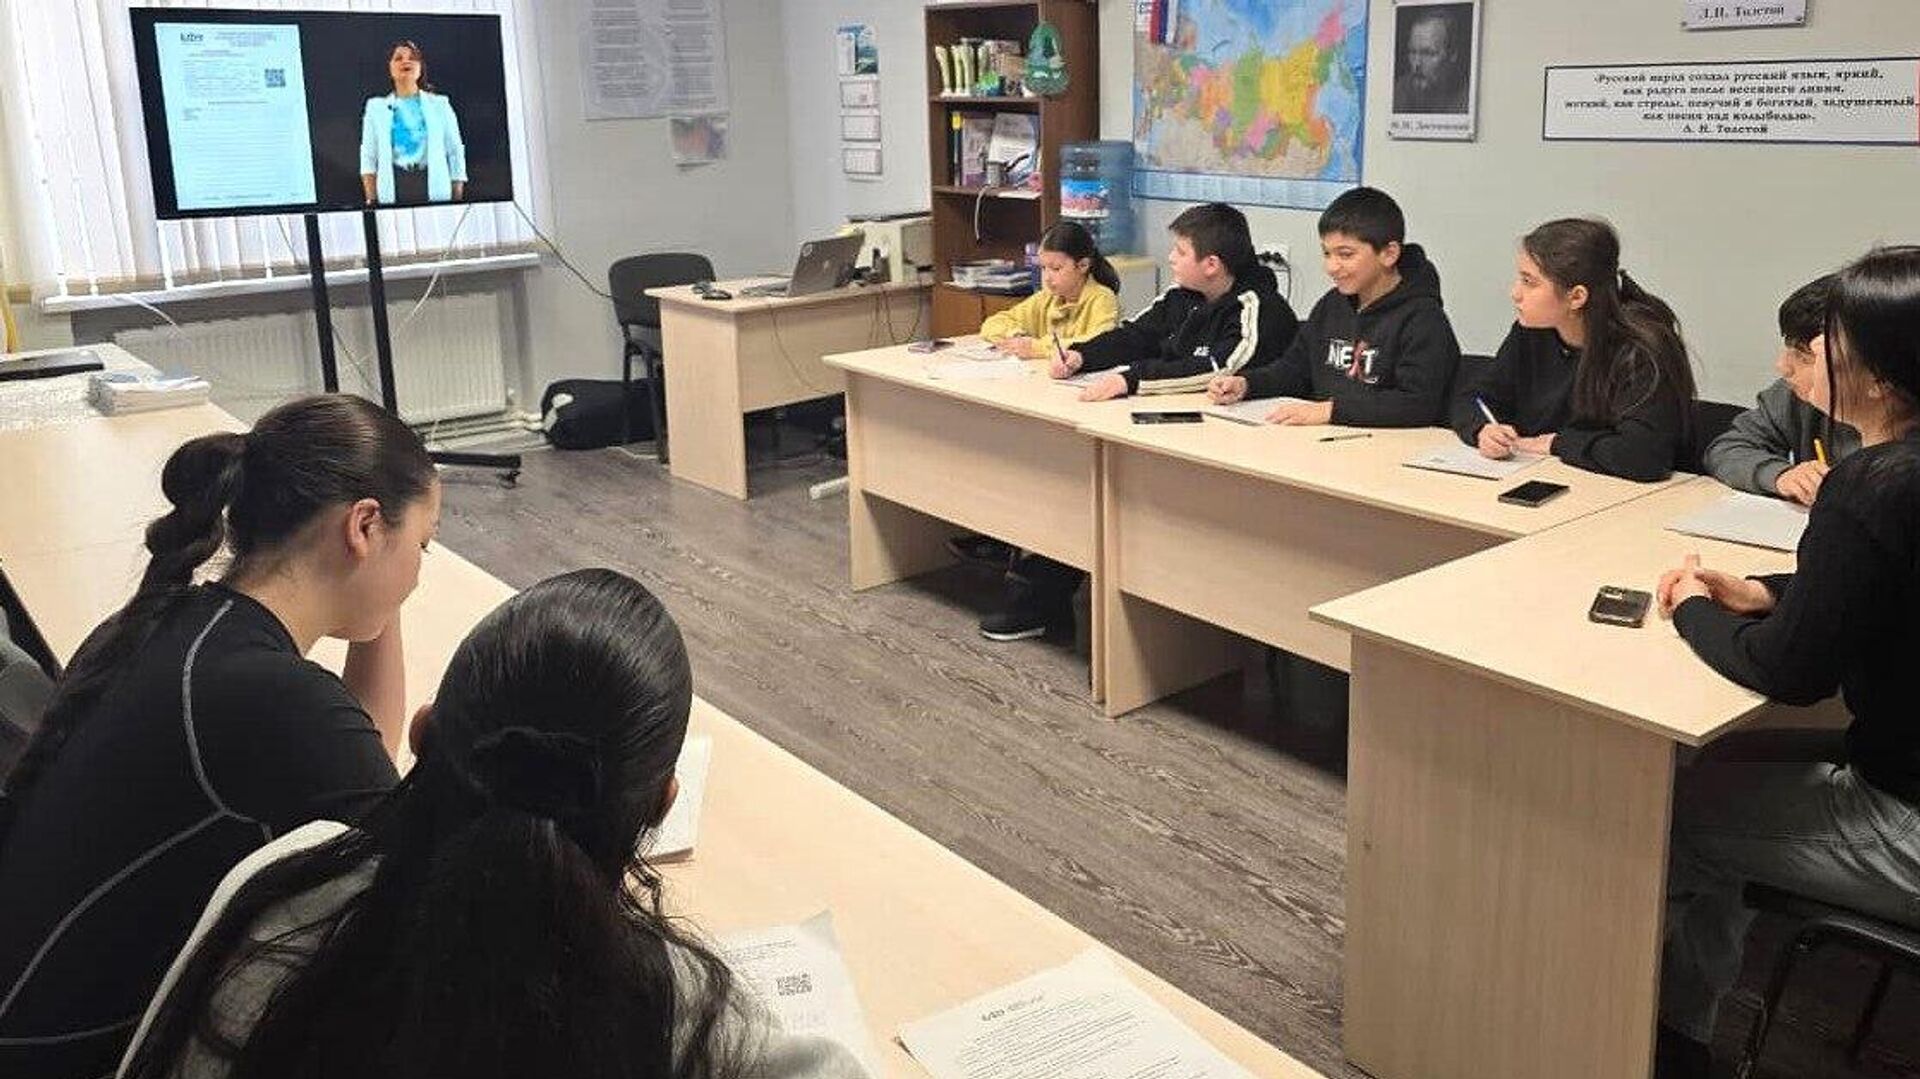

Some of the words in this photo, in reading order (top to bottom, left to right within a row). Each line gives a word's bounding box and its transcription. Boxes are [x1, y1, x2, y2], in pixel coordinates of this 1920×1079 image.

[1734, 6, 1784, 17] Толстой
[1650, 74, 1685, 83] народ
[1734, 71, 1787, 83] русский
[1716, 123, 1768, 133] Толстой
